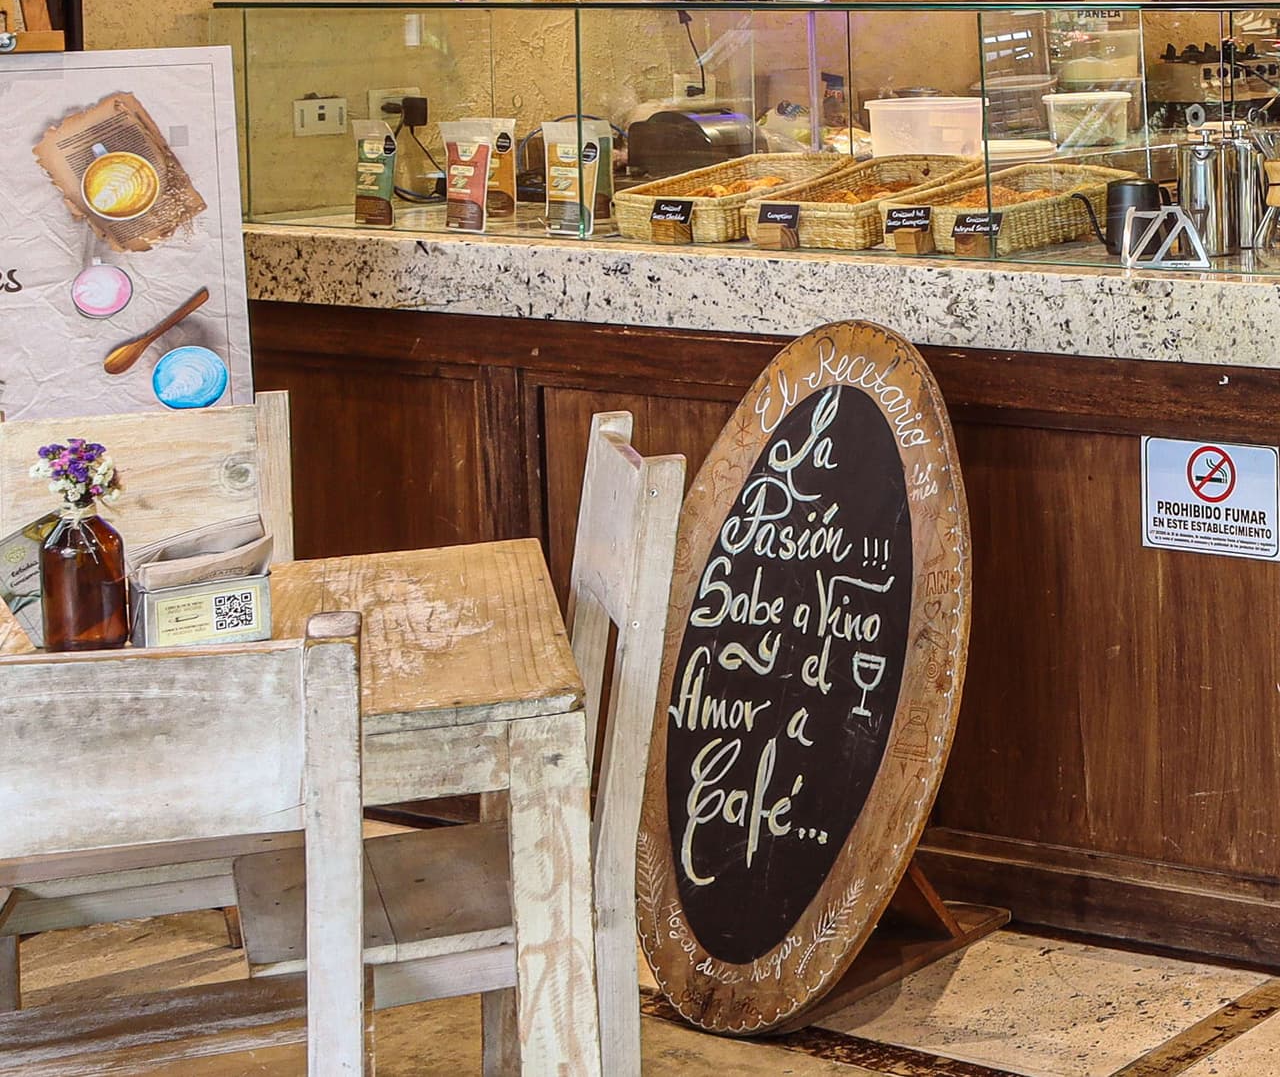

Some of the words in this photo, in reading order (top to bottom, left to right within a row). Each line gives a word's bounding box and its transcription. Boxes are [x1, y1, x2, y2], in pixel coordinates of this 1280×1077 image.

[1077, 9, 1121, 19] PANELA
[755, 369, 798, 433] El
[803, 337, 931, 448] Recetario
[768, 385, 843, 501] La
[720, 475, 853, 563] Pasión
[1152, 516, 1165, 528] EN
[1166, 518, 1189, 531] ESTE
[1191, 520, 1272, 540] ESTABLECIMIENTO
[1157, 500, 1222, 521] PROHIBIDO
[1225, 507, 1267, 526] FUMAR
[690, 556, 785, 628] Sabe
[793, 603, 811, 634] a
[817, 570, 895, 642] Vino
[668, 646, 772, 732] Amor
[787, 706, 814, 746] a
[801, 635, 832, 695] el
[751, 935, 802, 982] hogar
